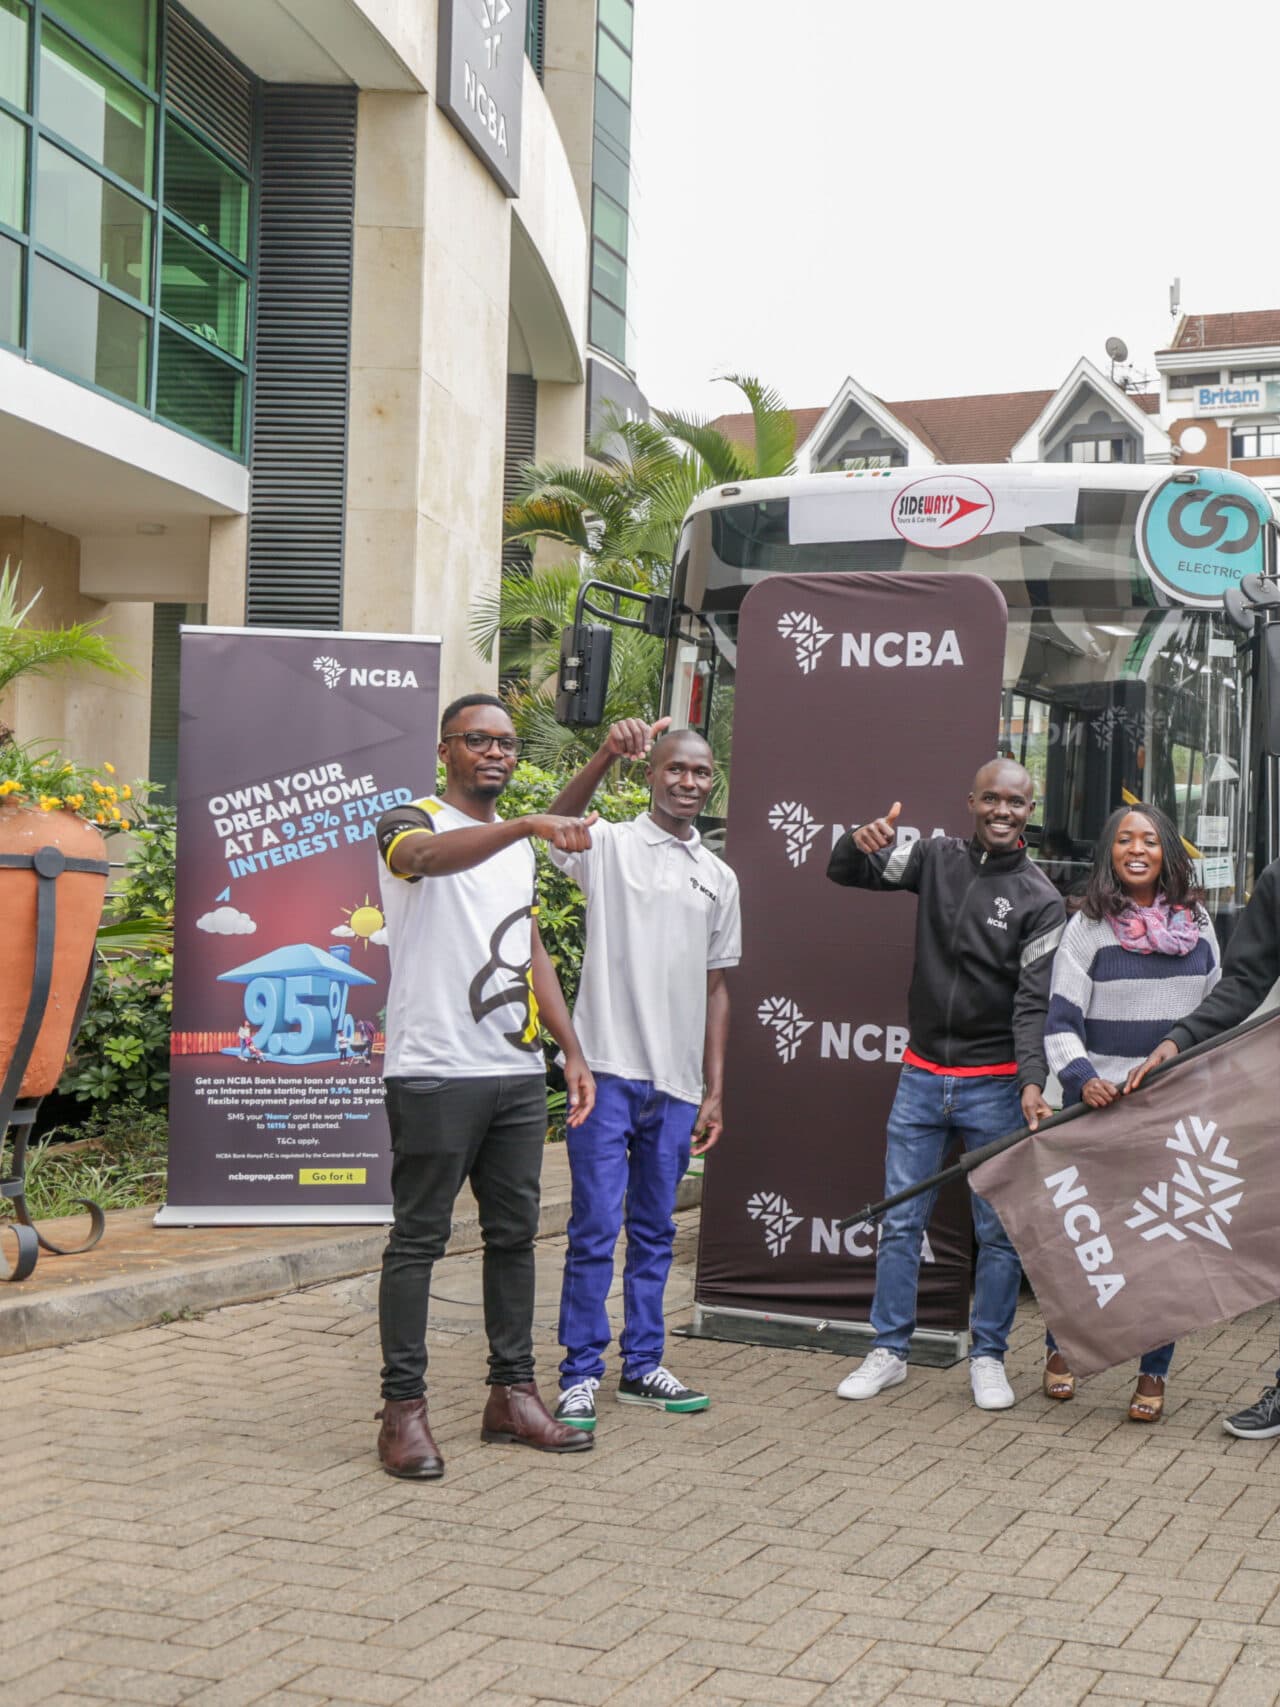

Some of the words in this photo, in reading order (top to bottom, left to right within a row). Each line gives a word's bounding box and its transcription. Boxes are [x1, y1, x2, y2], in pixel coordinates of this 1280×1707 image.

[464, 60, 508, 157] NCBA
[1200, 387, 1259, 405] Britam
[899, 495, 954, 515] SIDEWAYS
[1178, 560, 1242, 580] ELECTRIC
[841, 630, 964, 667] NCBA
[350, 668, 418, 688] NCBA
[208, 783, 272, 815] OWN
[274, 762, 346, 796] YOUR
[214, 796, 303, 837] DREAM
[305, 774, 378, 811] HOME
[224, 833, 255, 859] AT
[262, 827, 280, 848] A
[281, 809, 341, 840] 9.5%
[342, 787, 413, 824] FIXED
[228, 829, 341, 879] INTEREST
[345, 816, 382, 844] RA
[987, 917, 1008, 931] NCBA
[820, 1021, 911, 1063] NCB
[195, 1087, 204, 1095] at
[220, 1087, 252, 1095] Interest
[254, 1087, 272, 1095] rate
[274, 1087, 306, 1096] starting
[308, 1086, 328, 1094] from
[353, 1086, 370, 1094] and
[372, 1087, 388, 1096] enj
[336, 1078, 346, 1086] up
[241, 1098, 287, 1106] repayment
[289, 1097, 316, 1106] period
[228, 1172, 294, 1182] ncbagroup.com
[312, 1172, 327, 1182] Go
[329, 1172, 344, 1181] for
[346, 1172, 354, 1181] it
[811, 1217, 936, 1262] NC
[1043, 1165, 1126, 1309] NCBA
